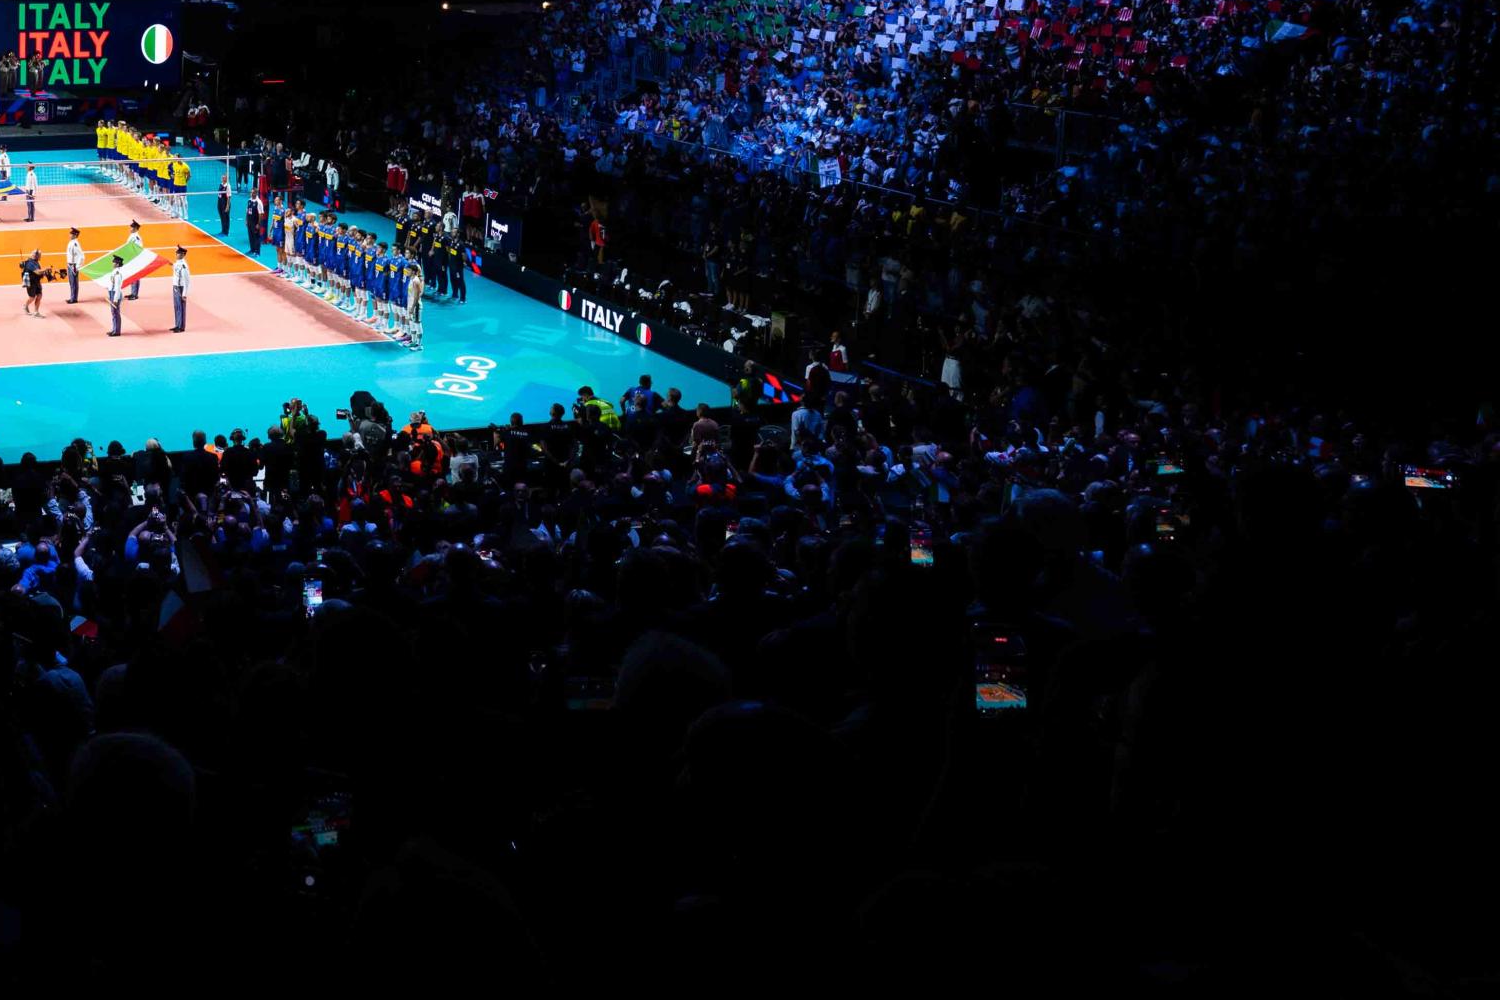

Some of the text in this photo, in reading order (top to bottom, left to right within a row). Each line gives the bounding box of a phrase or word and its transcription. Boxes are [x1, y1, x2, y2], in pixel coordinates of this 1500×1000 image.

[17, 2, 111, 30] ITALY
[18, 31, 110, 59] ITALY
[491, 219, 509, 233] Napoli
[581, 298, 625, 334] ITALY
[427, 355, 498, 401] enel
